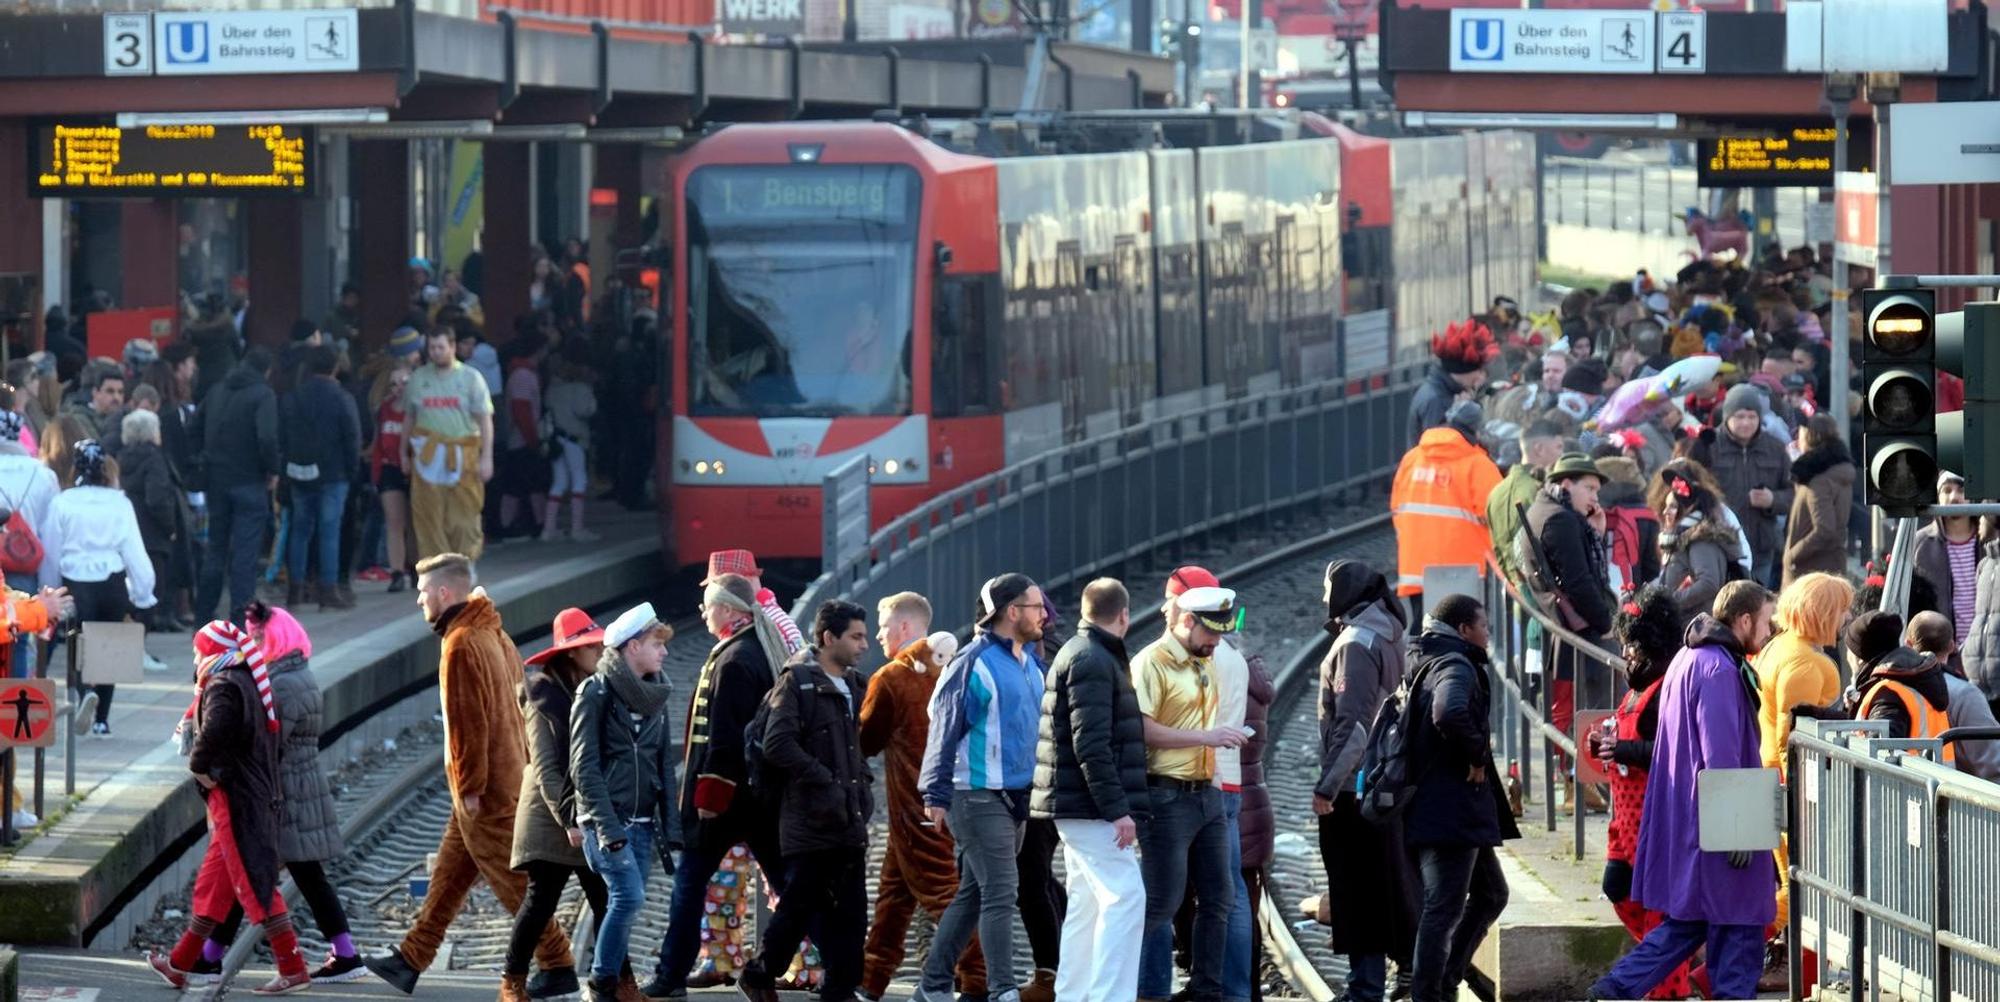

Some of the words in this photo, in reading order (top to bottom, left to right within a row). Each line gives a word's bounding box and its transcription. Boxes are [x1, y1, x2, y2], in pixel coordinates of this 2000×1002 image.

[168, 22, 208, 62] U
[222, 25, 257, 39] Über
[263, 26, 292, 39] den
[1463, 19, 1503, 60] U
[1518, 22, 1553, 38] Über
[1559, 24, 1588, 38] den
[115, 32, 141, 67] 3
[219, 43, 295, 59] Bahnsteig
[1514, 43, 1591, 59] Bahnsteig
[1667, 32, 1696, 66] 4
[764, 179, 885, 211] Bensberg
